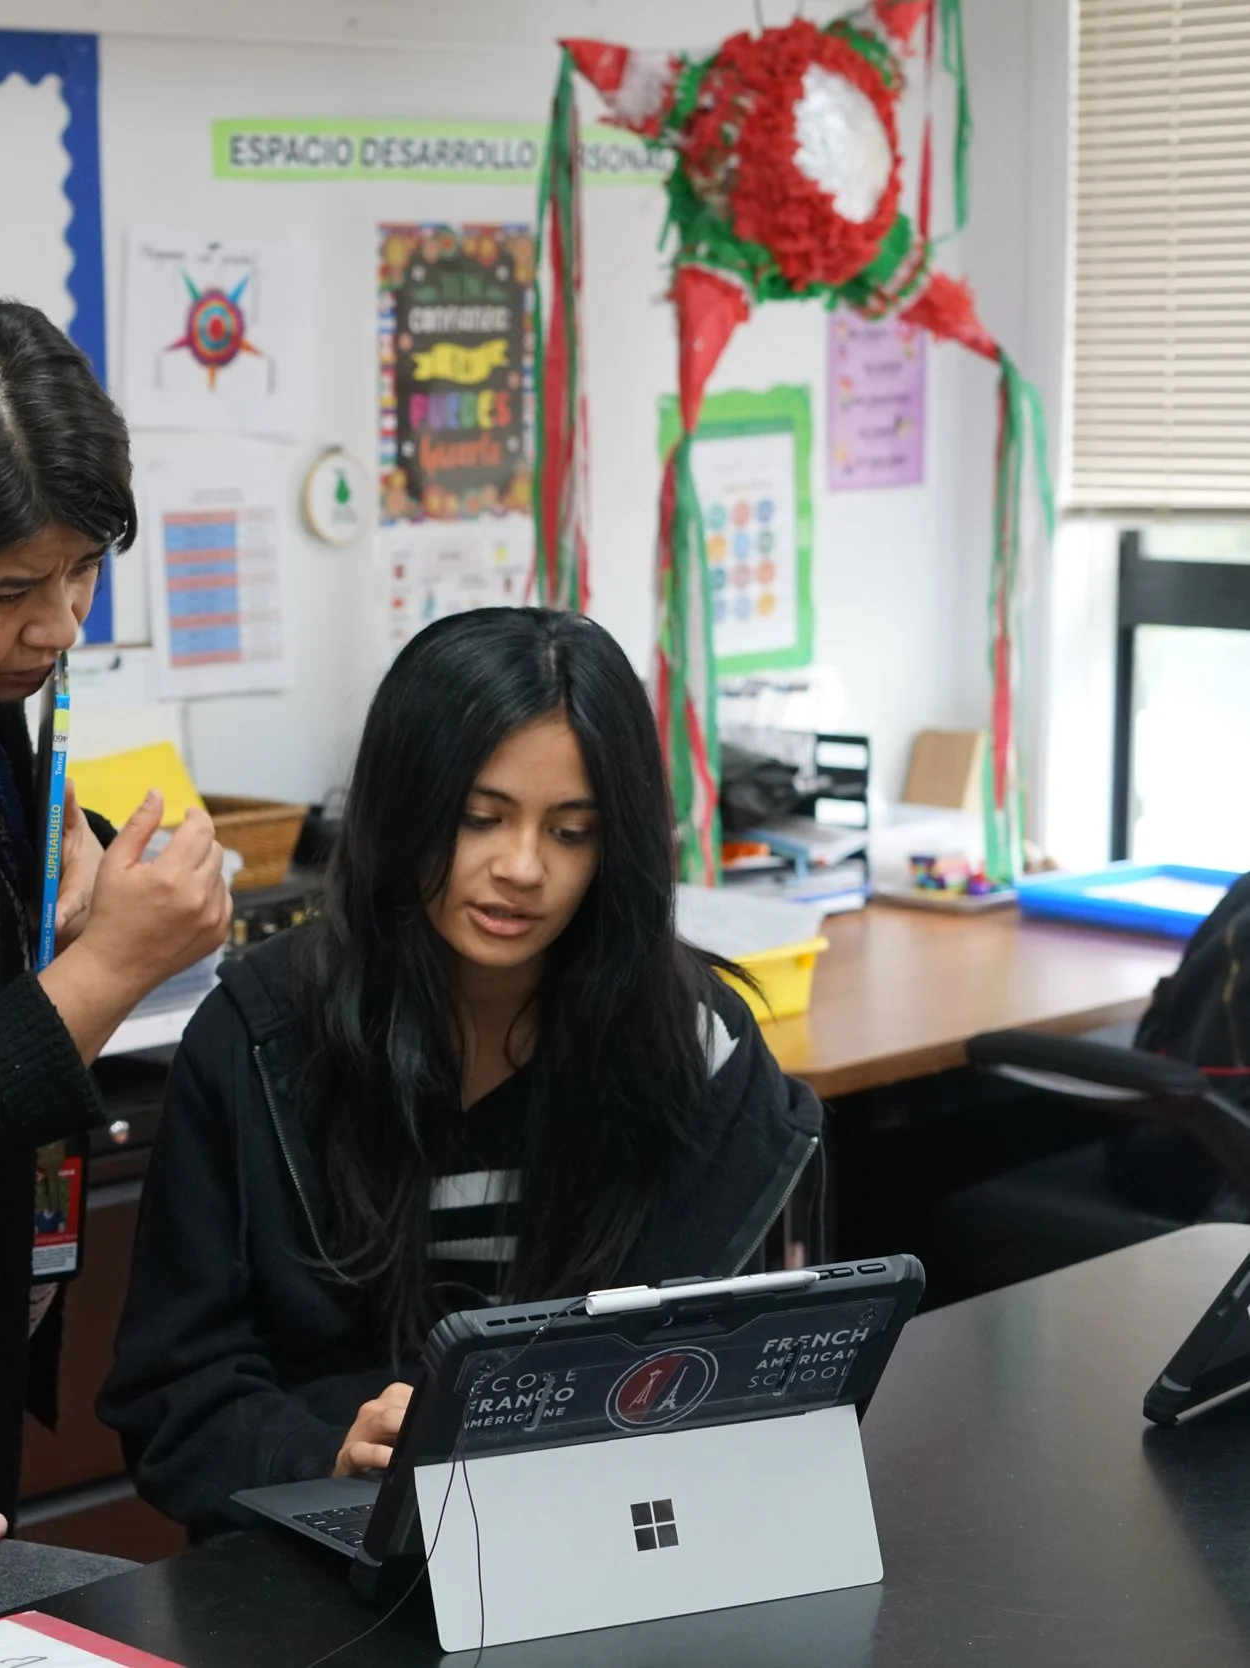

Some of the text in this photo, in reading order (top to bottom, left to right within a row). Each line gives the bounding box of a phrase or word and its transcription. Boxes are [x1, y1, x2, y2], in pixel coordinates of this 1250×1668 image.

[230, 135, 354, 167] ESPACIO
[360, 137, 537, 170] DESARROLLO
[46, 803, 62, 879] SUPERABUELO
[44, 903, 54, 929] Dodson
[762, 1327, 870, 1354] FRENCH
[755, 1348, 858, 1370] AMERICAN
